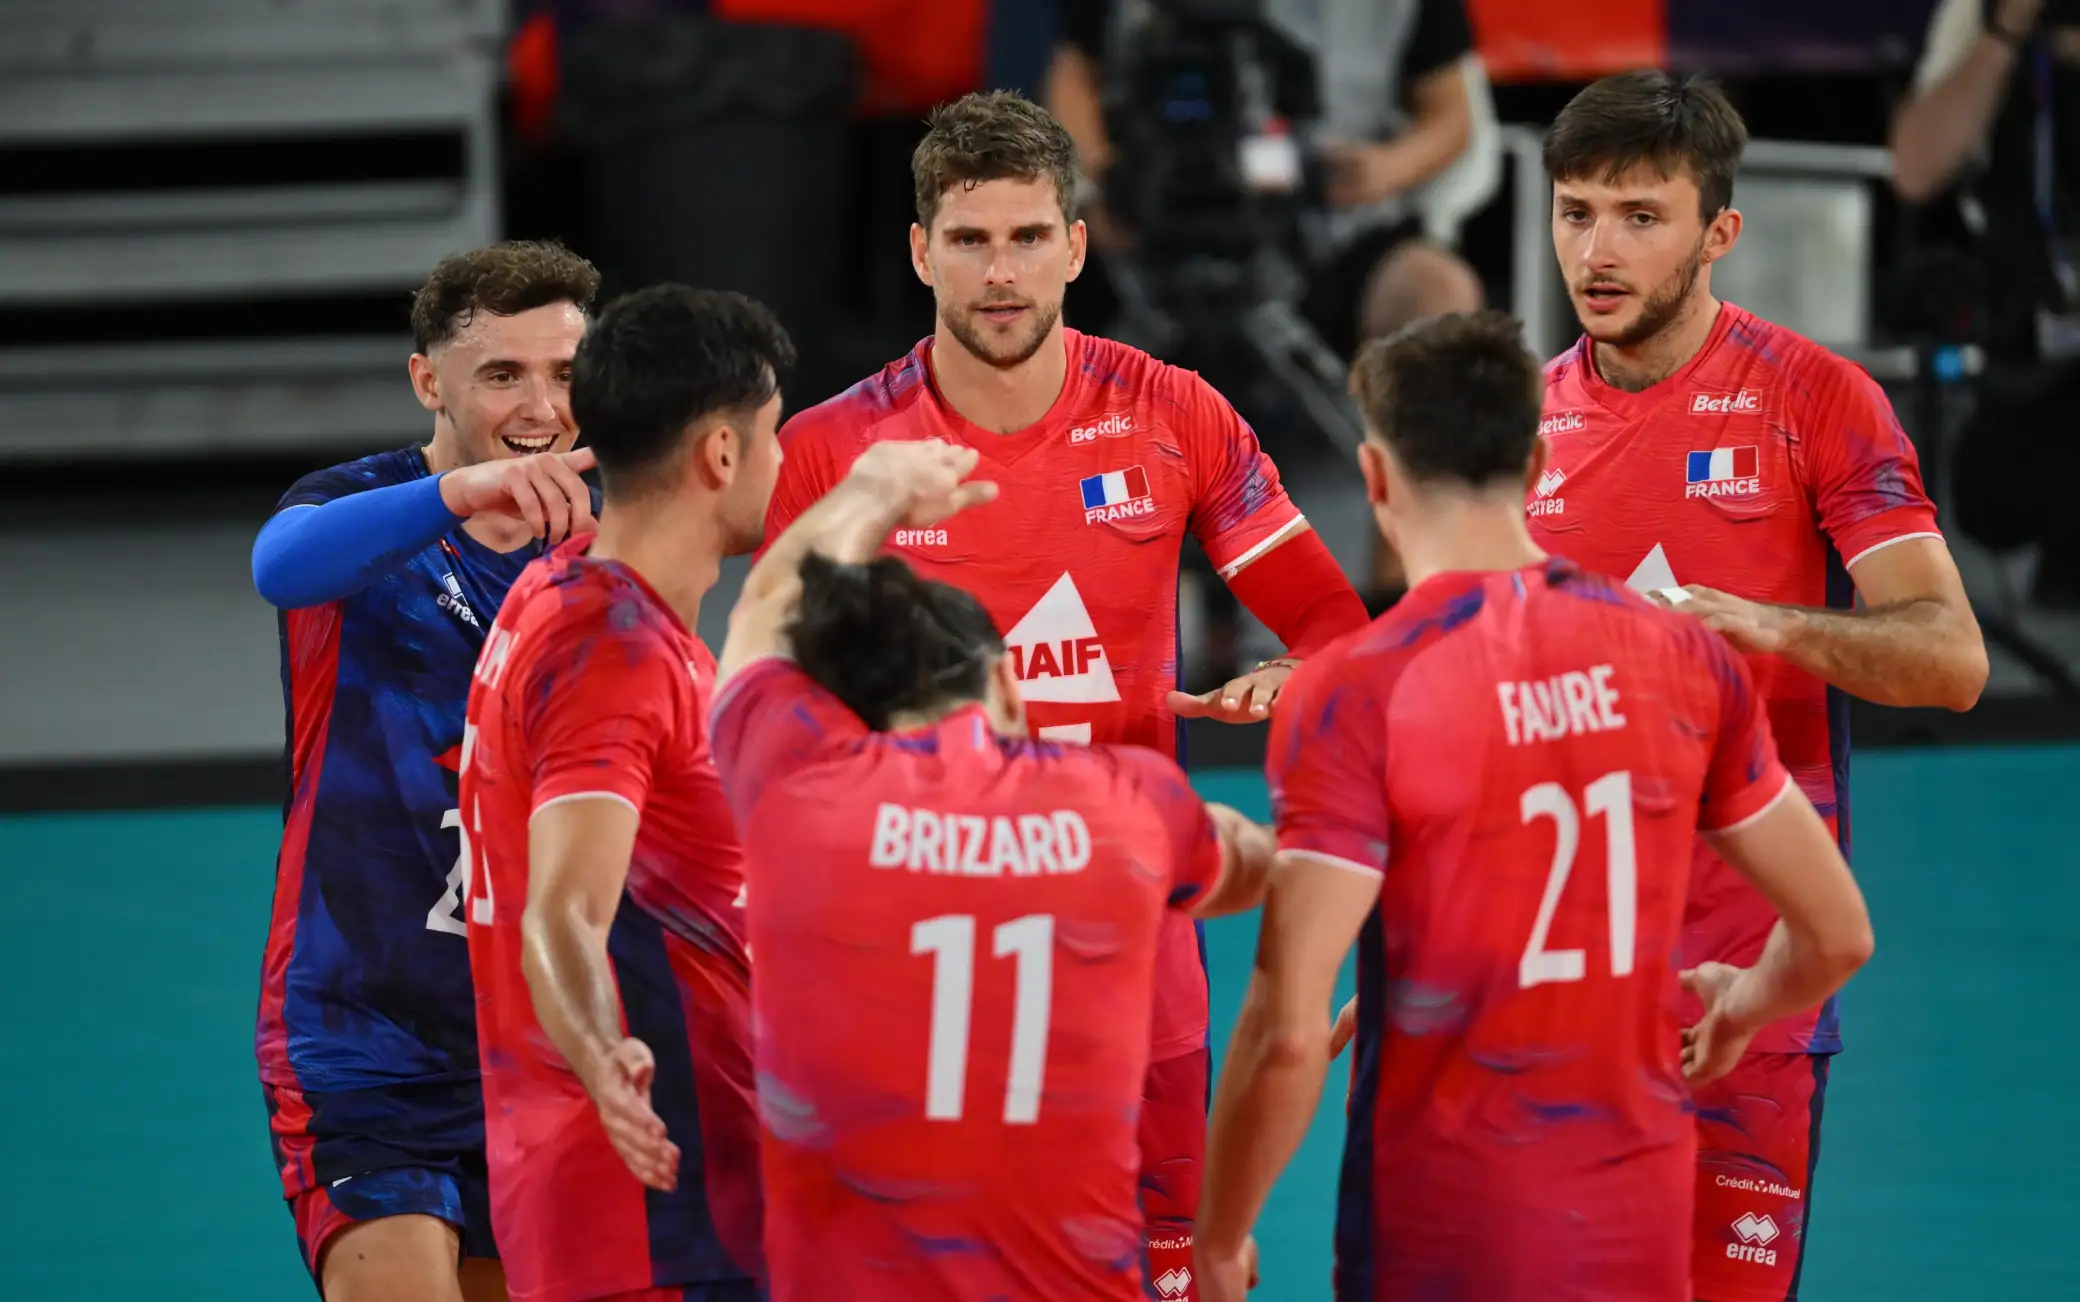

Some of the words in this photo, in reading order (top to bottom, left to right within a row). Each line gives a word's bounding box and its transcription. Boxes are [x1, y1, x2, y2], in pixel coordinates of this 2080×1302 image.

[1071, 415, 1132, 442] Betclic
[1685, 479, 1759, 499] FRANCE
[1085, 498, 1155, 525] FRANCE
[895, 529, 948, 546] errea
[1497, 664, 1626, 746] FAURE
[869, 802, 1092, 876] BRIZARD
[1518, 771, 1637, 988] 21
[909, 914, 1054, 1124] 11
[1716, 1174, 1754, 1191] Crédit
[1768, 1183, 1801, 1199] Mutuel
[1148, 1239, 1175, 1250] rédit
[1726, 1242, 1777, 1266] errea
